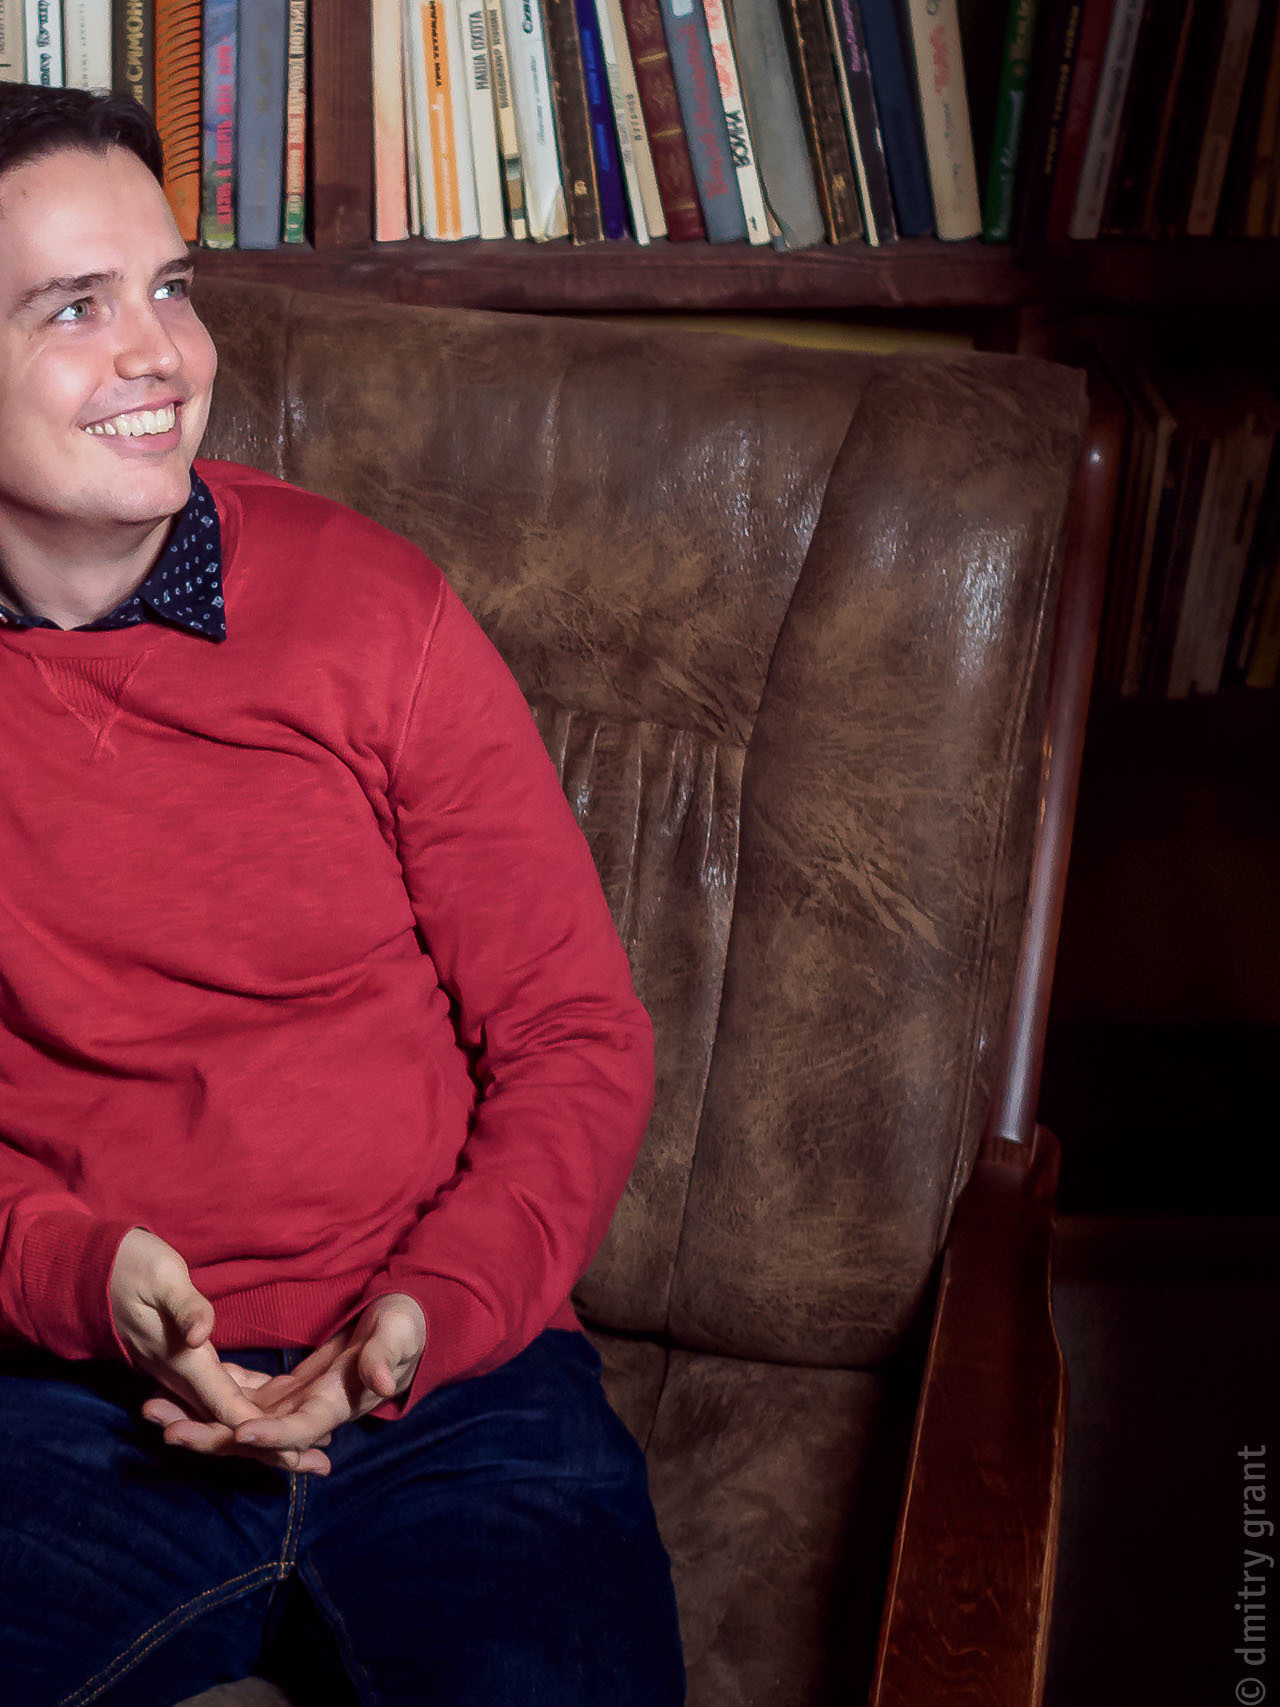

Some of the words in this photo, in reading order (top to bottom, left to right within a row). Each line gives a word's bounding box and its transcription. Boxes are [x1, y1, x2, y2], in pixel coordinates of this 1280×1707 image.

[124, 0, 146, 82] СИМОН
[469, 10, 486, 50] ОХОТА
[471, 51, 490, 90] НАША
